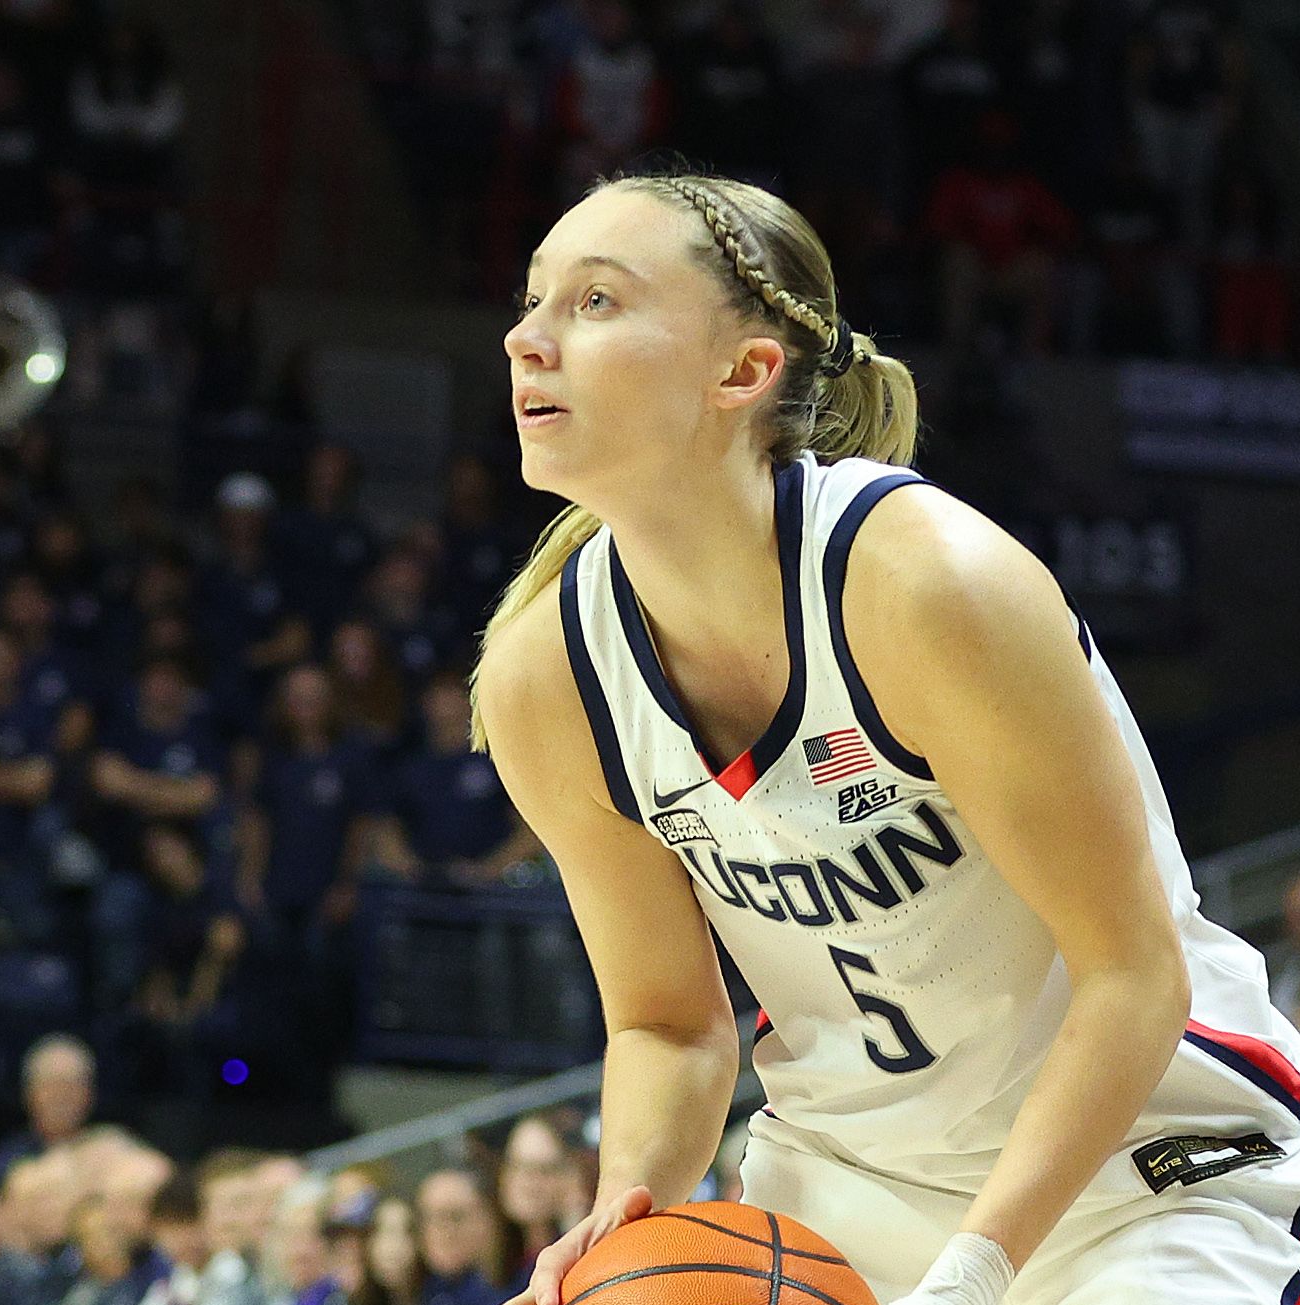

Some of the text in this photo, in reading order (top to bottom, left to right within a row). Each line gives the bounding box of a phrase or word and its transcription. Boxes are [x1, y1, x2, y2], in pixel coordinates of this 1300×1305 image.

[838, 778, 878, 807] BIG
[838, 784, 899, 821] EAST
[682, 801, 966, 927] UCONN
[827, 943, 940, 1075] 5
